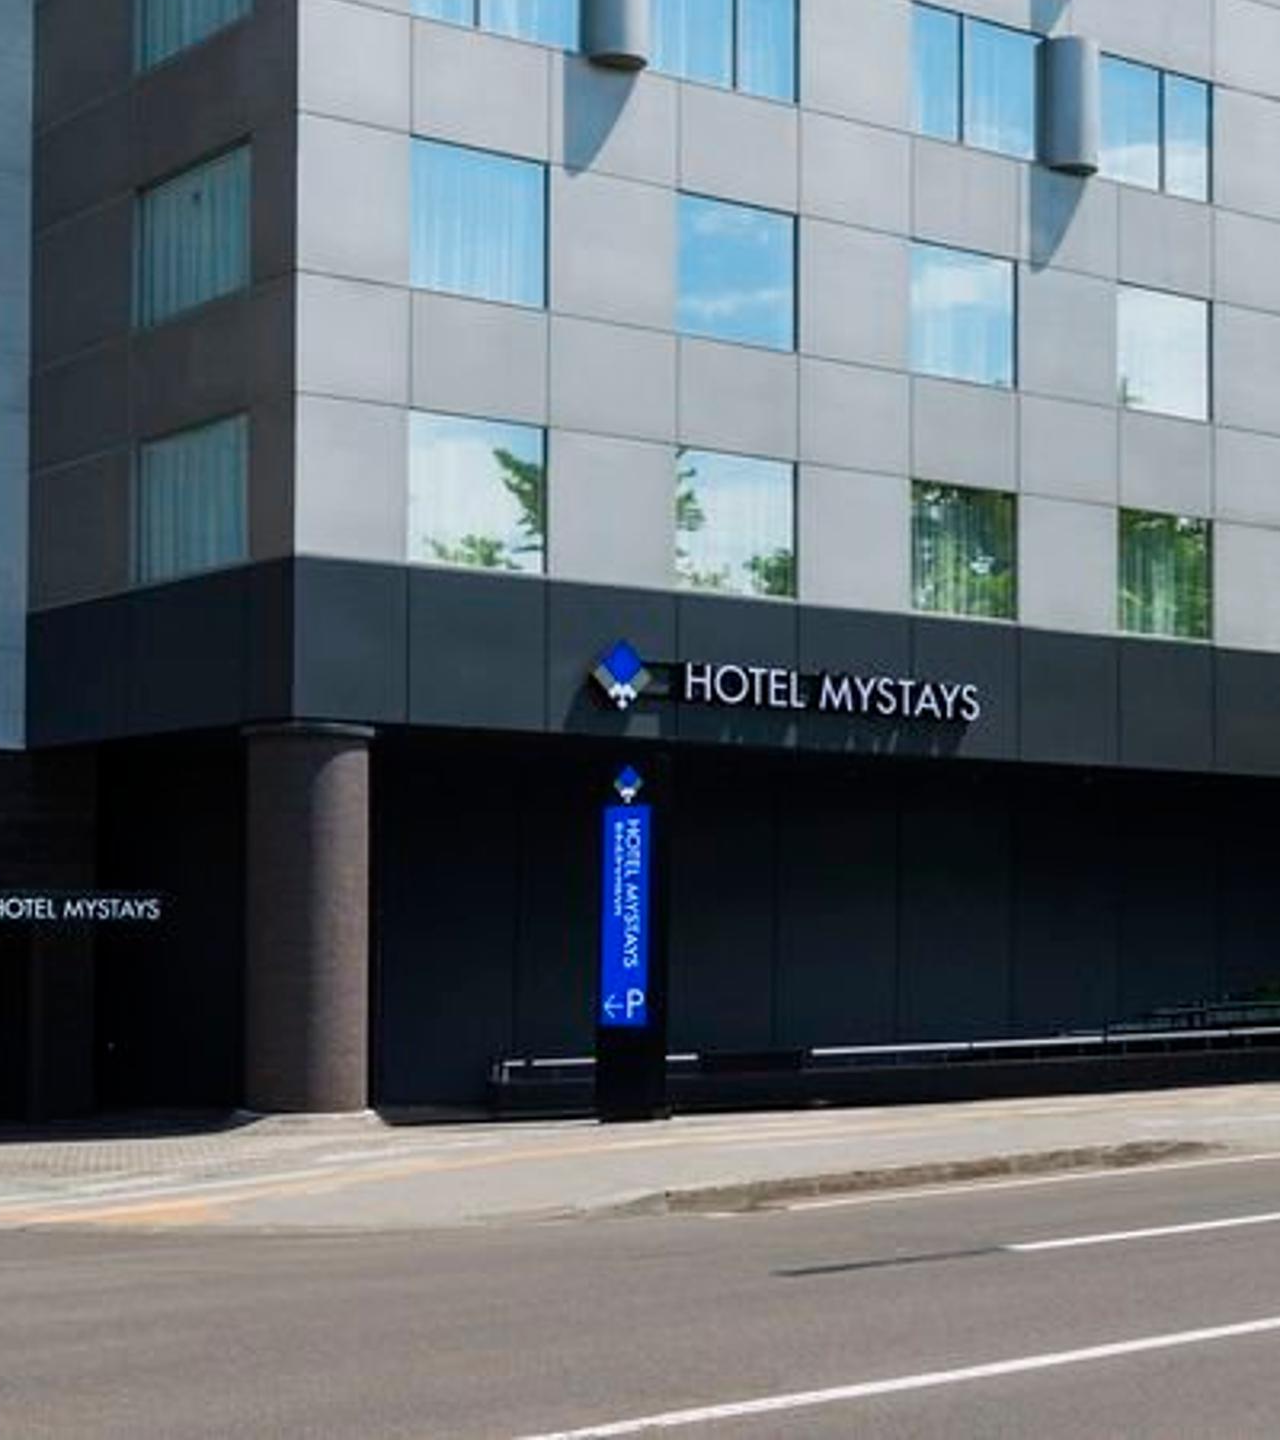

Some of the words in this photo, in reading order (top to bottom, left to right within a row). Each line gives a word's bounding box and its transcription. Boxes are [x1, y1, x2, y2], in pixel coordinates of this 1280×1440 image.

[685, 661, 806, 709] HOTEL
[819, 674, 980, 722] MYSTAYS
[623, 818, 641, 878] HOTEL
[63, 897, 161, 921] MYSTAYS
[623, 882, 640, 968] MYSTAYS
[626, 988, 645, 1019] P
